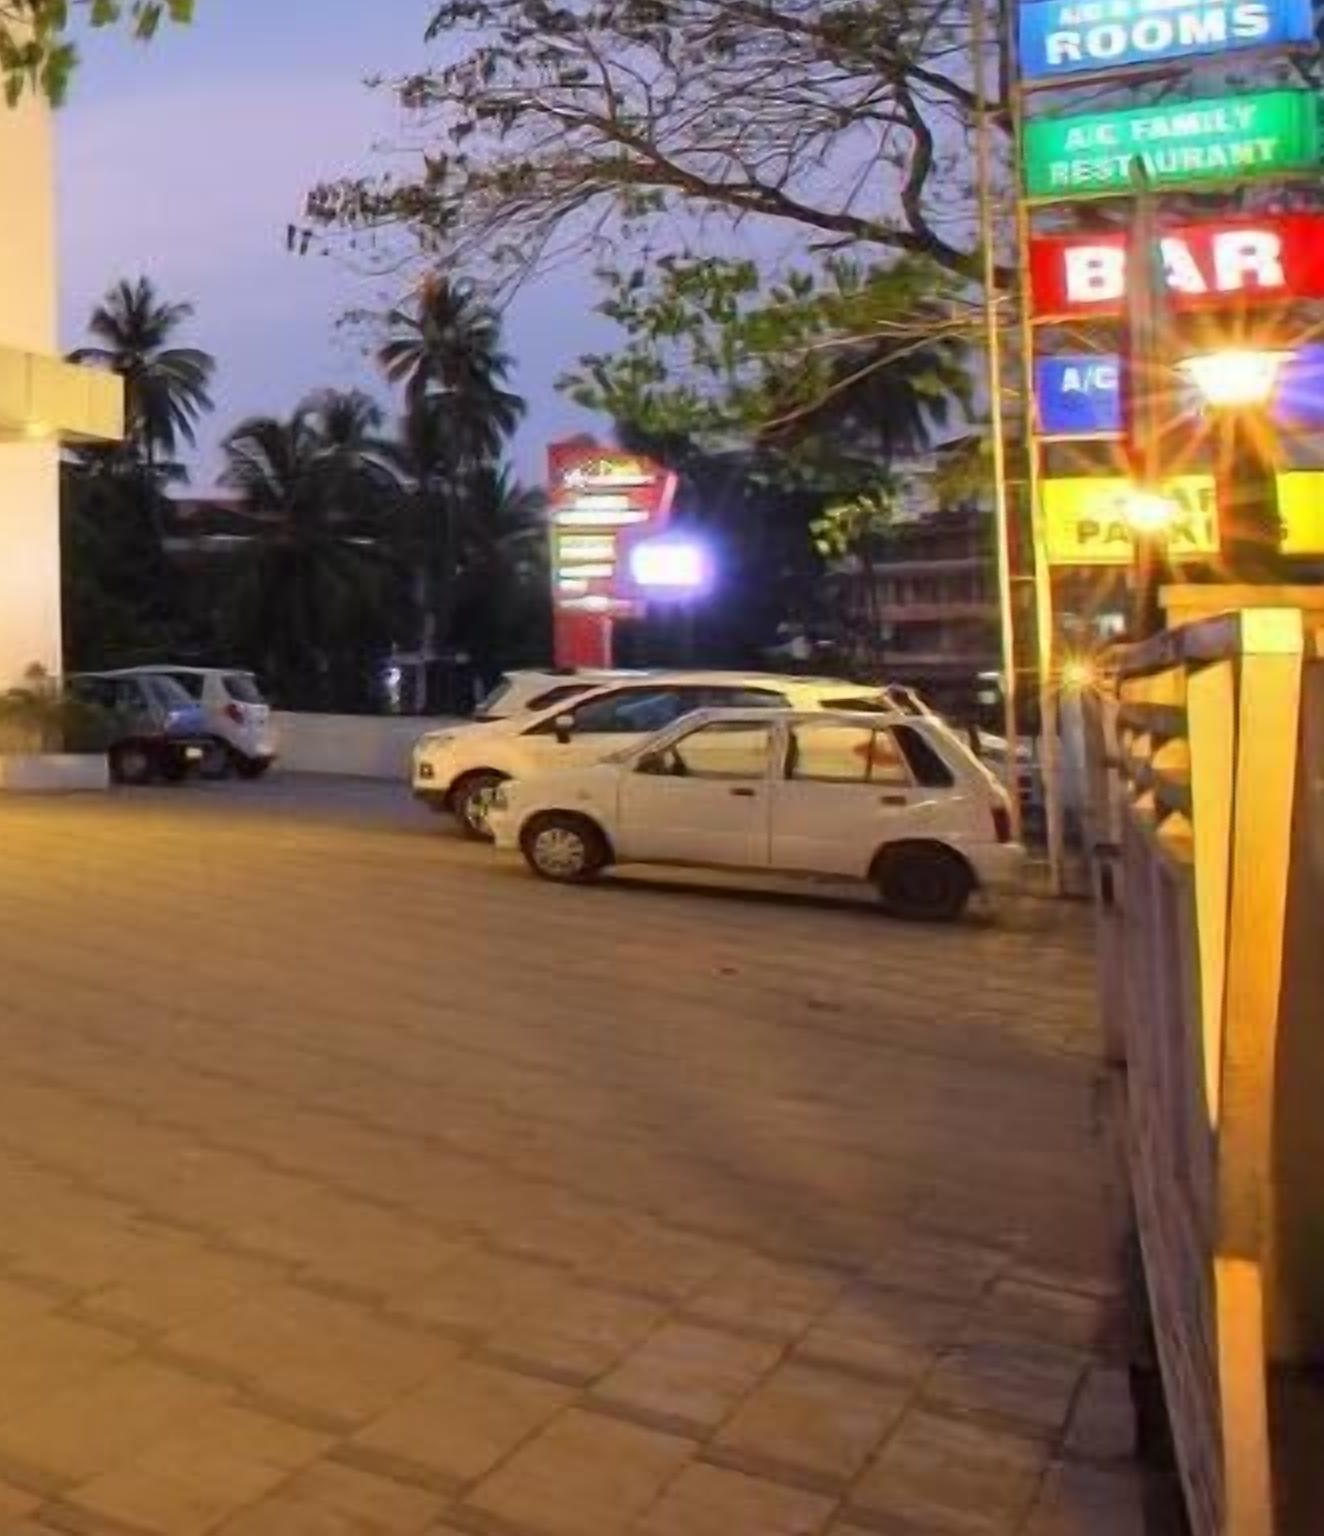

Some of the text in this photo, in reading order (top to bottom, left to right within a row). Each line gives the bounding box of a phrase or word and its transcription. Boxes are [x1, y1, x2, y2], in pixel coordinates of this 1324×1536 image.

[1045, 3, 1270, 64] ROOMS
[1128, 103, 1257, 141] FAMILY
[1063, 230, 1285, 304] BAR
